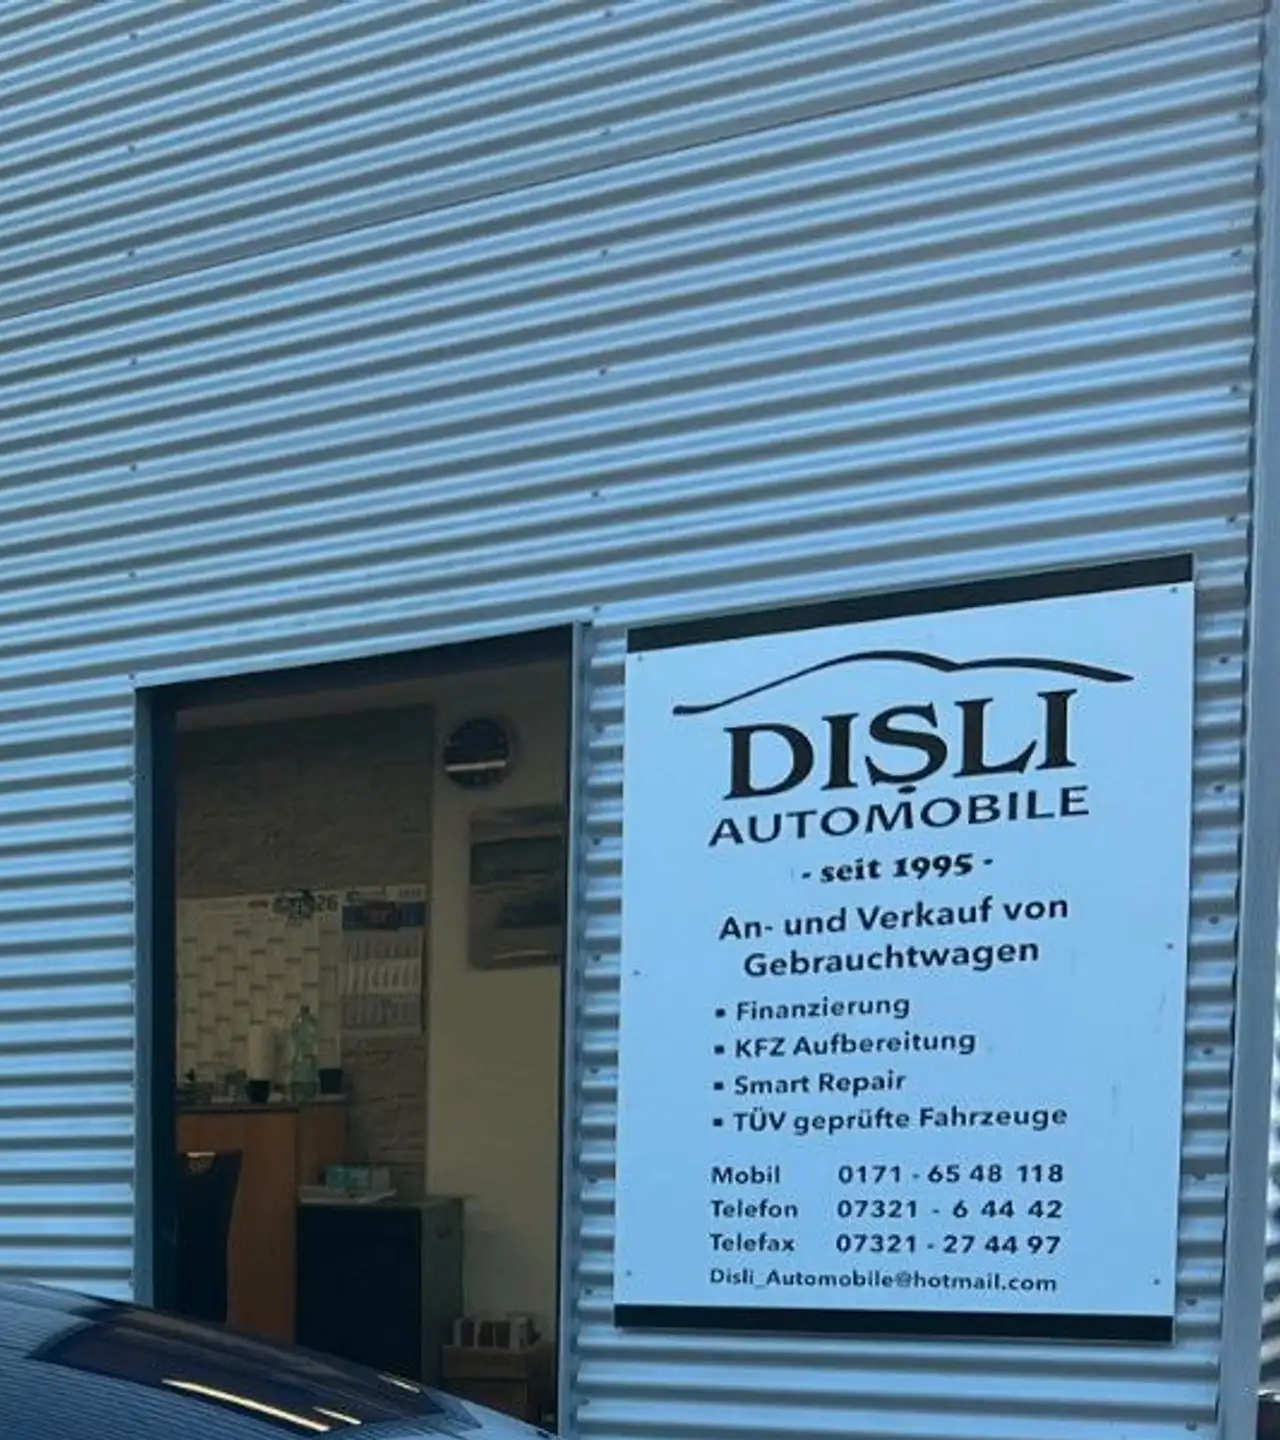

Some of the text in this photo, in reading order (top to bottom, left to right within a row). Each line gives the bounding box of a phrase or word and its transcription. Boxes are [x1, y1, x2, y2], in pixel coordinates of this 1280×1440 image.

[708, 785, 1090, 847] AUTOMOBILE
[820, 857, 881, 883] seit
[893, 852, 974, 881] 1995
[718, 895, 1068, 941] An- und Verkauf von
[743, 942, 1039, 978] Gebrauchtwagen
[736, 995, 910, 1022] Finanzierung
[735, 1029, 976, 1059] KFZ Aufbereitung
[734, 1068, 907, 1098] Smart Repair
[732, 1105, 1068, 1137] TÜV geprüfte Fahrzeuge
[711, 1164, 780, 1185] Mobil
[838, 1164, 901, 1185] 0171
[927, 1164, 961, 1184] 65
[969, 1163, 1003, 1184] 48
[1017, 1163, 1064, 1183] 118
[710, 1198, 799, 1218] Telefon
[837, 1199, 917, 1219] 07321
[952, 1199, 969, 1219] 6
[980, 1199, 1015, 1219] 44
[1027, 1199, 1063, 1219] 42
[709, 1231, 795, 1252] Telefax
[835, 1233, 916, 1254] 07321
[943, 1234, 976, 1254] 27
[984, 1235, 1018, 1255] 44
[1027, 1235, 1061, 1255] 97
[709, 1267, 1057, 1293] Disli_Automobile@hotmail.com
